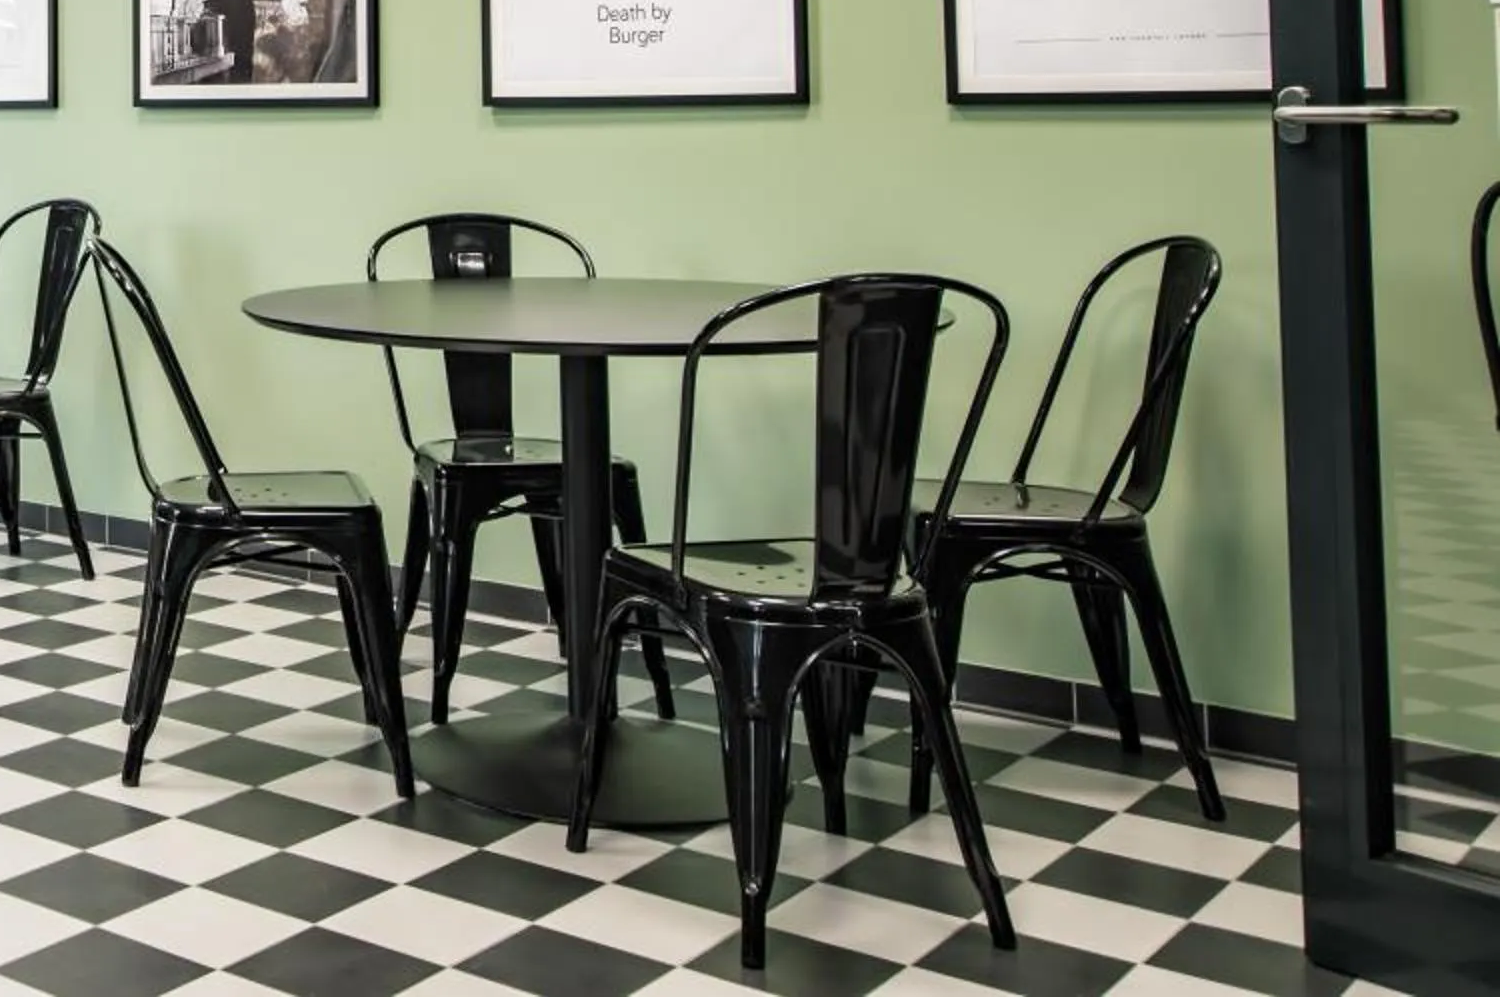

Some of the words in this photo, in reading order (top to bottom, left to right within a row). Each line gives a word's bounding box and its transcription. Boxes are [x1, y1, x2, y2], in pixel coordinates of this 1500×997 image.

[597, 3, 647, 22] Death
[651, 3, 672, 23] by
[609, 26, 664, 47] Burger
